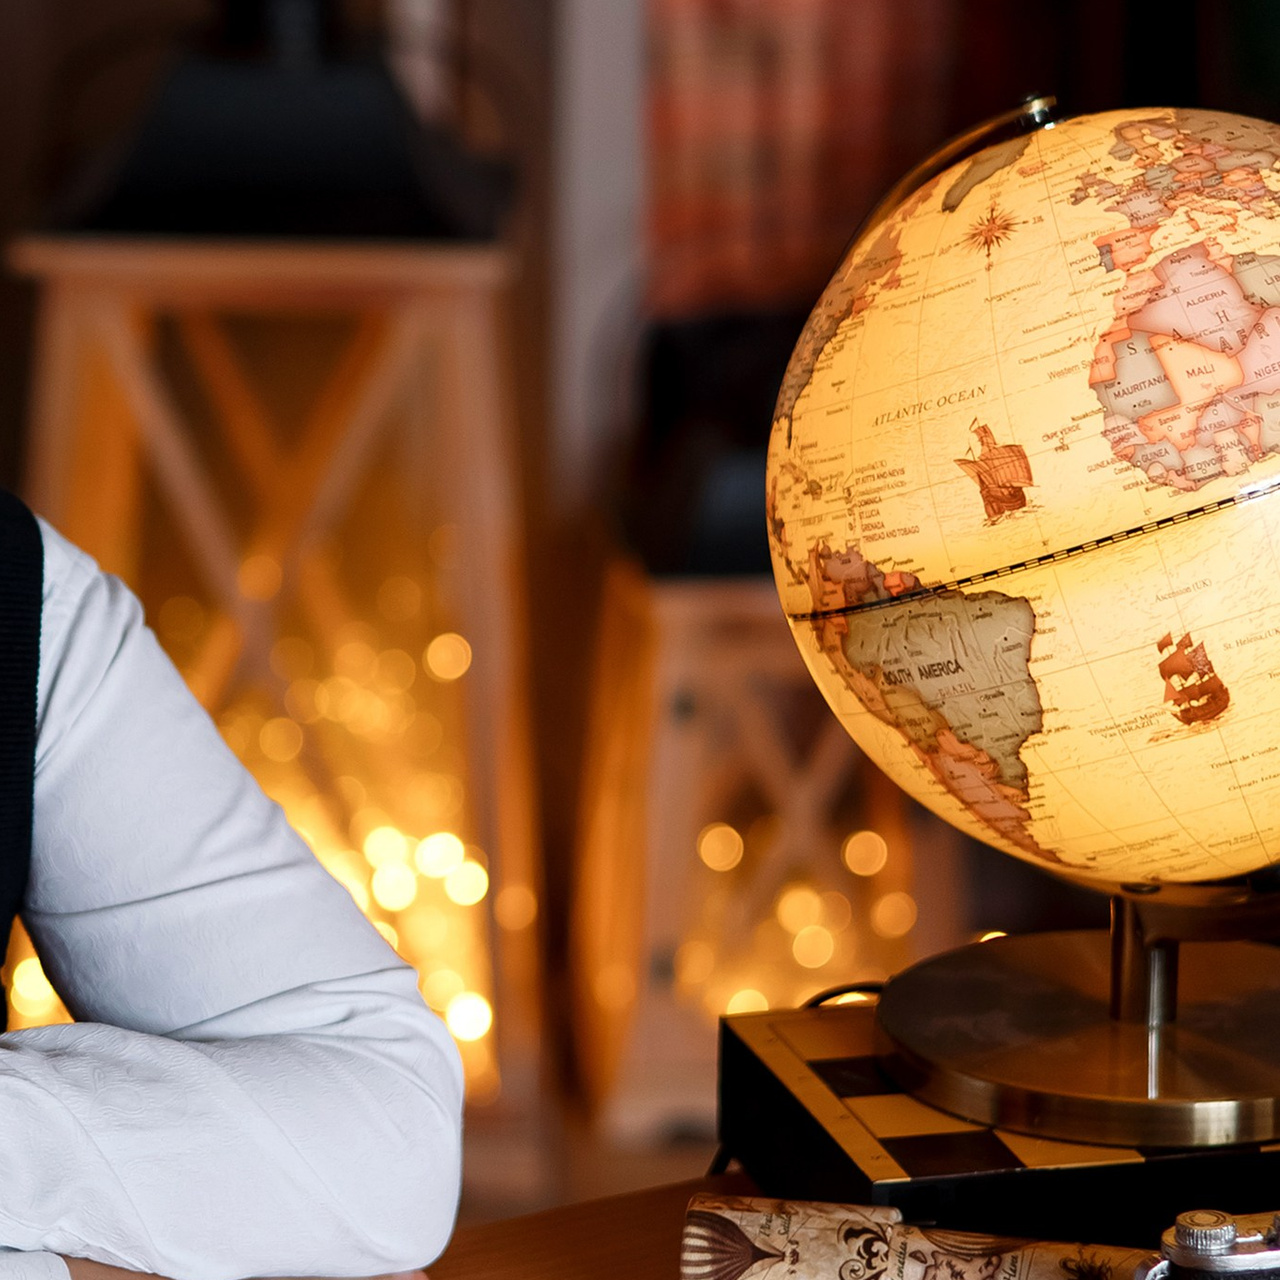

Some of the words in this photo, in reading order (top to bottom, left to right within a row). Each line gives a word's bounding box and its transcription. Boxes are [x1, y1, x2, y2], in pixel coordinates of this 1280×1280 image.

[1114, 232, 1137, 244] Madrid
[1169, 254, 1192, 266] Algiers
[1122, 284, 1165, 302] MOROCCO
[1186, 289, 1228, 308] ALGERIA
[1047, 362, 1081, 380] Western
[1186, 364, 1216, 379] MALI
[1113, 373, 1170, 400] MAURITANIA
[871, 400, 933, 428] ATLANTIC
[937, 384, 987, 408] OCEAN
[1137, 399, 1152, 408] Kiffa
[1158, 413, 1181, 427] Bamako
[1209, 420, 1227, 431] FASO
[1239, 414, 1265, 430] BENIN
[1214, 439, 1244, 454] GHANA
[1238, 443, 1259, 457] TOGO
[1141, 447, 1171, 463] GUINEA
[857, 496, 883, 508] DOMINICA
[860, 521, 886, 533] GRENADA
[862, 531, 886, 543] TRINIDAD
[897, 525, 921, 537] TOBAGO
[1154, 586, 1192, 604] Ascension
[1192, 578, 1213, 593] (UK)
[883, 669, 915, 687] SOUTH
[917, 658, 965, 681] AMERICA
[938, 683, 976, 699] BRAZIL
